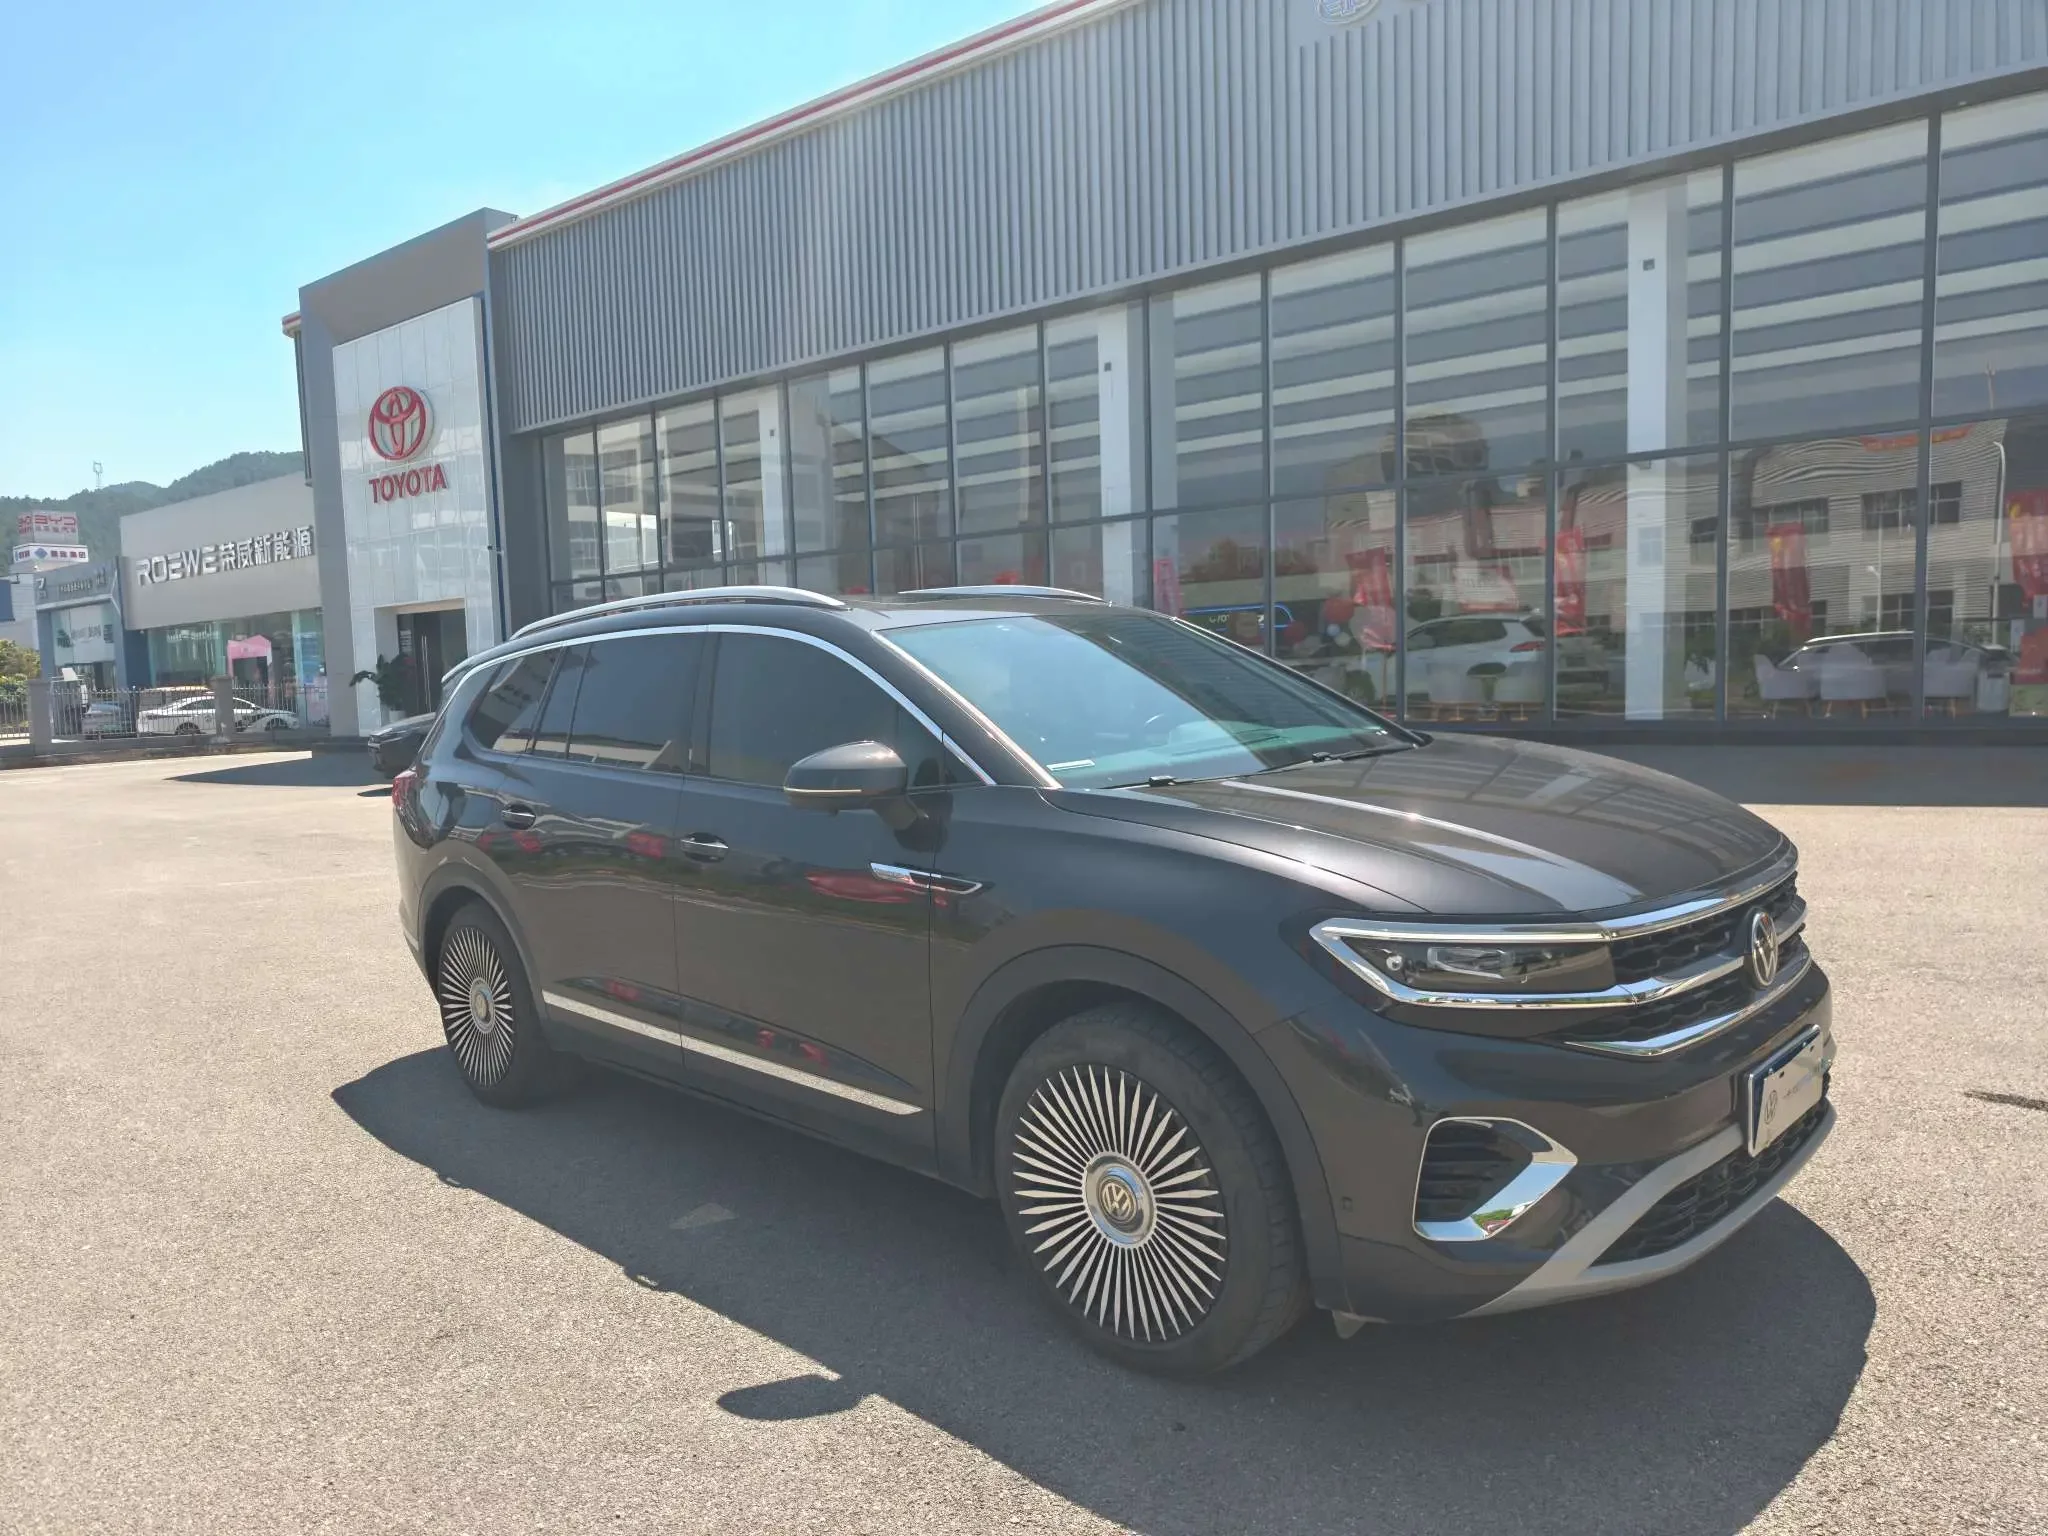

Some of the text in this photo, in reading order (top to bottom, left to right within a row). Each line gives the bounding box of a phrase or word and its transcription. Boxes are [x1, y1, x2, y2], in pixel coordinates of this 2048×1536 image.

[369, 463, 447, 503] TOYOTA
[34, 514, 76, 527] BYD
[136, 544, 217, 587] ROEWE
[219, 525, 313, 571] 荣威新能源
